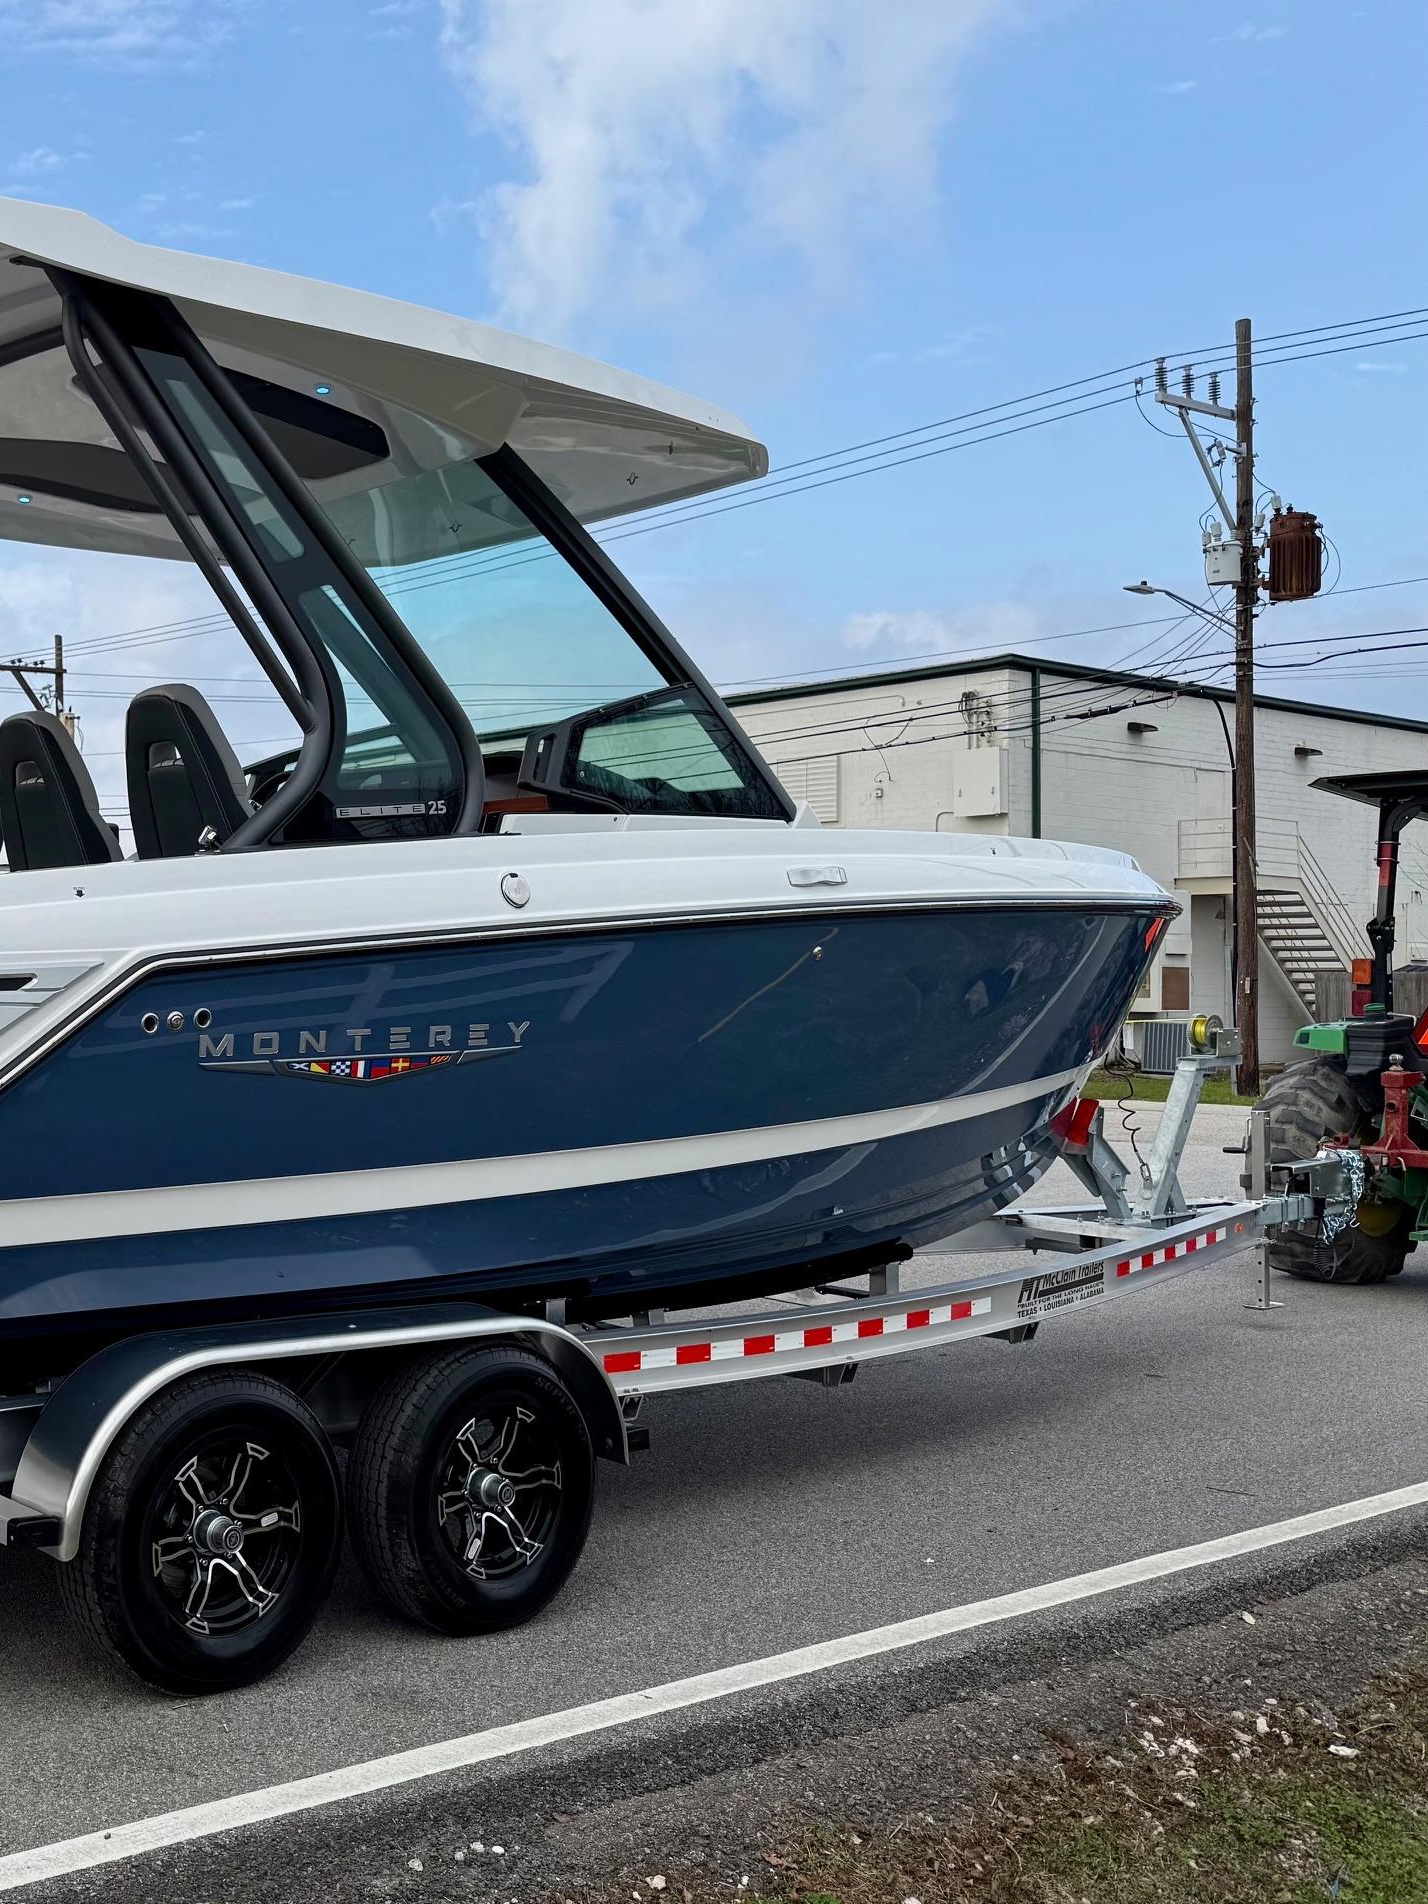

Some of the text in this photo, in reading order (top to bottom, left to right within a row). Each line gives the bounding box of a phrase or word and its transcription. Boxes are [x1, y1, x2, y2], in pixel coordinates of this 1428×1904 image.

[340, 800, 447, 816] ELITE 25
[199, 1021, 530, 1057] MONTEREY
[1042, 1261, 1104, 1289] McClain Trailers
[1017, 1288, 1104, 1318] TEXAS LOUISIANA ALABAMA
[1065, 1288, 1084, 1297] LONG
